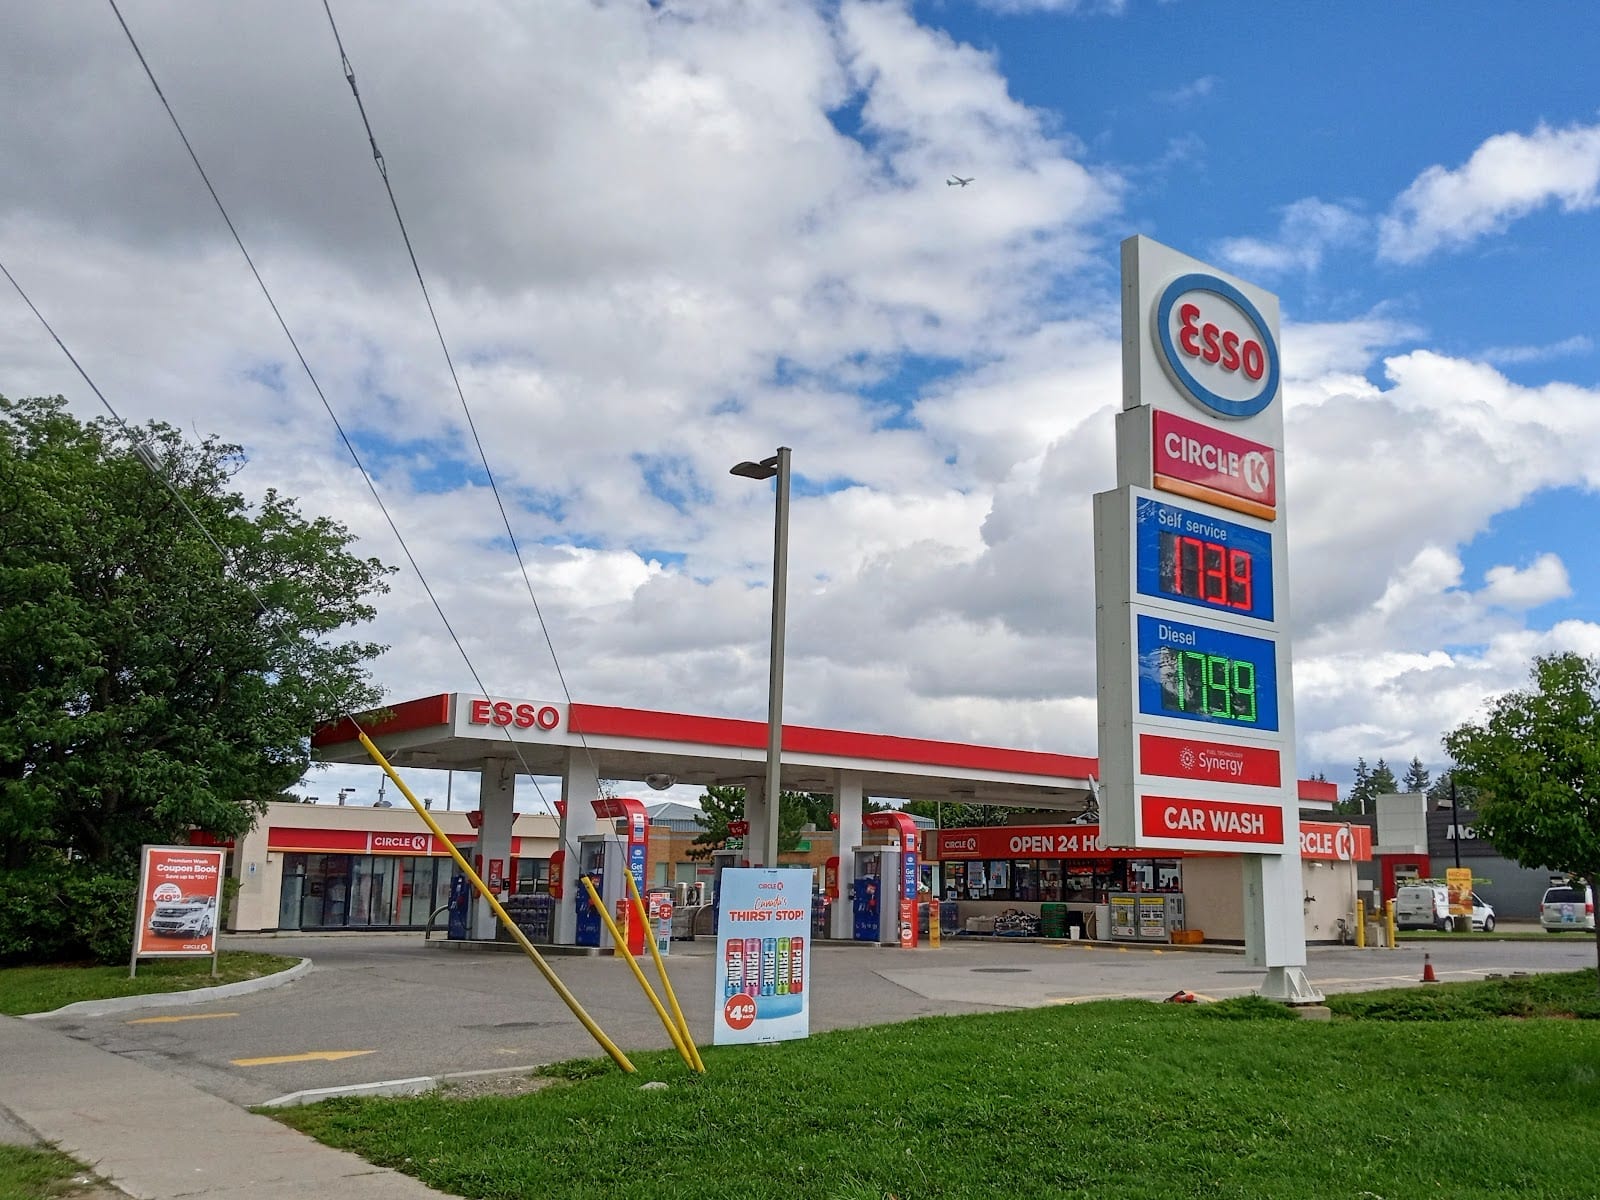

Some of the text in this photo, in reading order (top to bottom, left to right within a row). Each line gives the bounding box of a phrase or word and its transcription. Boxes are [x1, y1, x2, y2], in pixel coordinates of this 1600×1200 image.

[1164, 432, 1269, 492] CIRCLE K
[1158, 509, 1227, 540] Self service
[1158, 624, 1196, 646] Diesel
[471, 699, 560, 731] ESSO
[1199, 752, 1243, 776] Synergy
[1164, 806, 1264, 835] CAR WASH
[374, 836, 425, 849] CIRCLE K
[944, 838, 976, 849] CIRCLE K
[1009, 836, 1053, 852] OPEN
[1058, 835, 1078, 851] 24
[156, 864, 217, 873] Coupon Book
[729, 910, 804, 921] THIRST STOP!
[727, 952, 742, 988] PRIME
[746, 951, 759, 988] PRIME
[763, 950, 776, 987] PRIME
[778, 950, 789, 986] PRIME
[791, 949, 802, 984] PRIME
